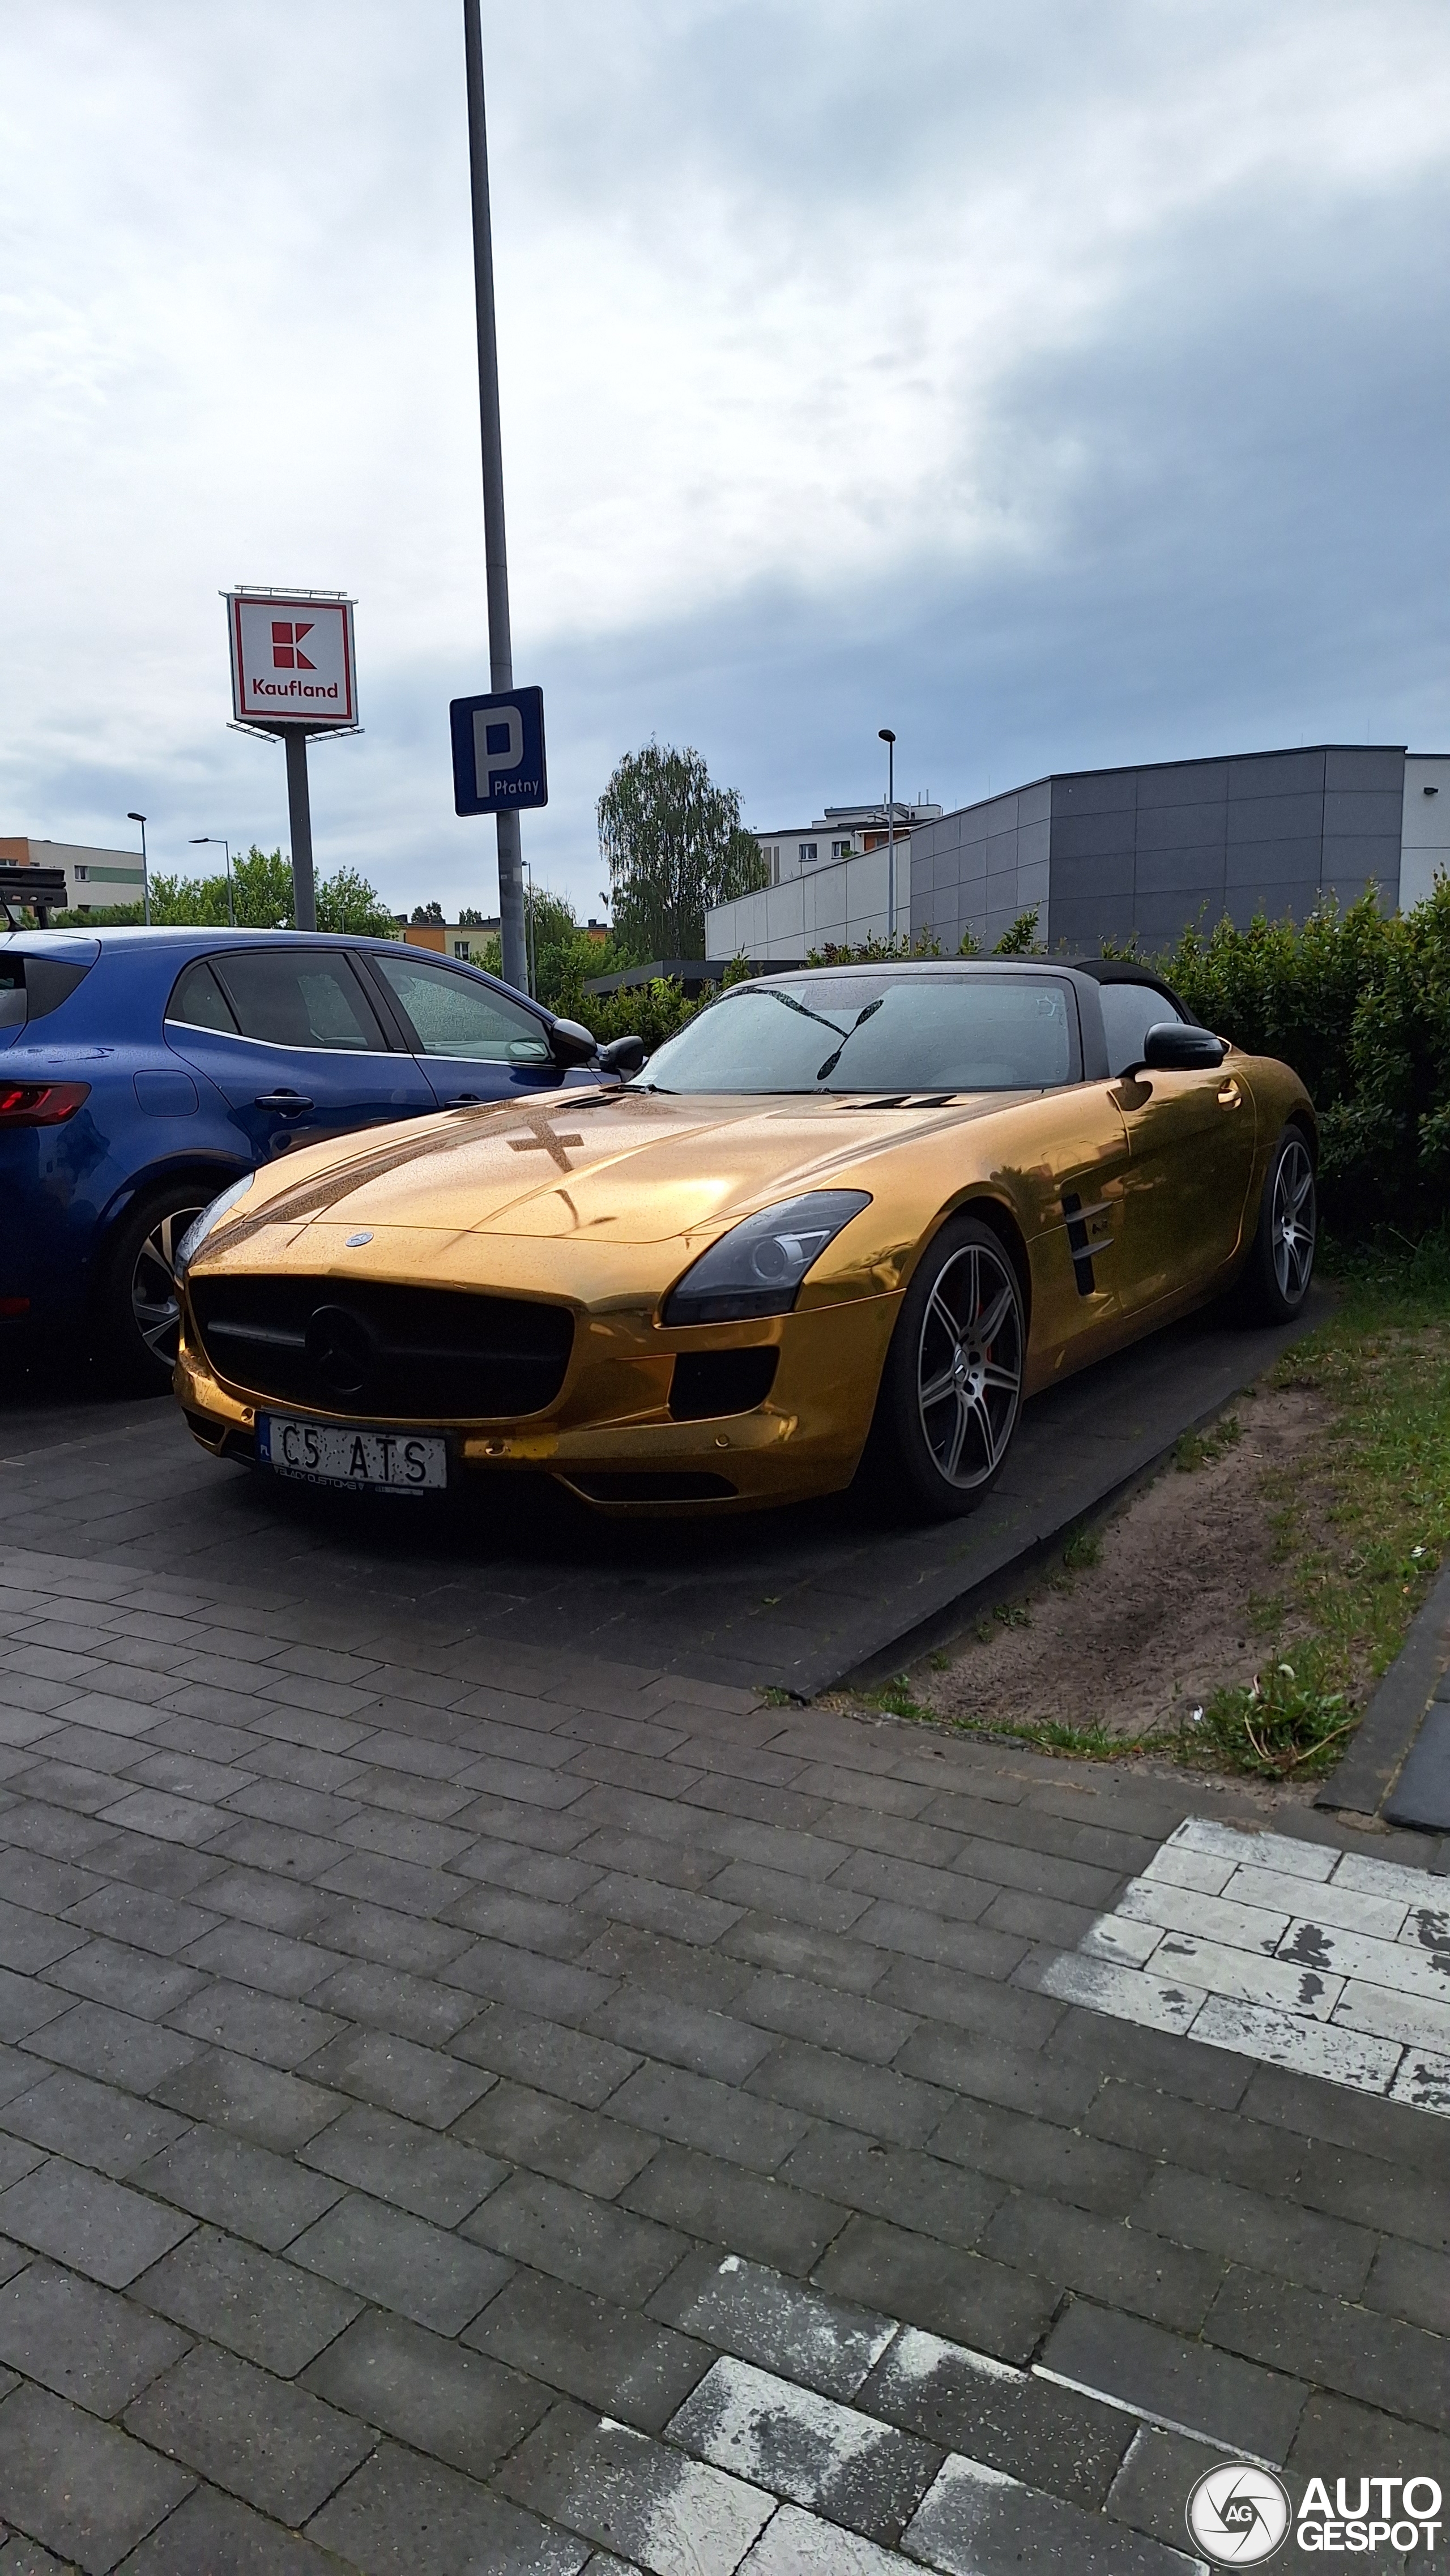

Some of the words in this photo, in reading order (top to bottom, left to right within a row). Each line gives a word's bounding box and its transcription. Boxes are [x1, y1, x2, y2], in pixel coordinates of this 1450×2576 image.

[253, 678, 339, 699] Kaufland
[472, 705, 524, 799] P
[494, 779, 539, 796] Płatny
[260, 1444, 270, 1456] PL
[283, 1424, 319, 1468] C5
[349, 1436, 427, 1483] ATS
[279, 1467, 306, 1481] BLACK
